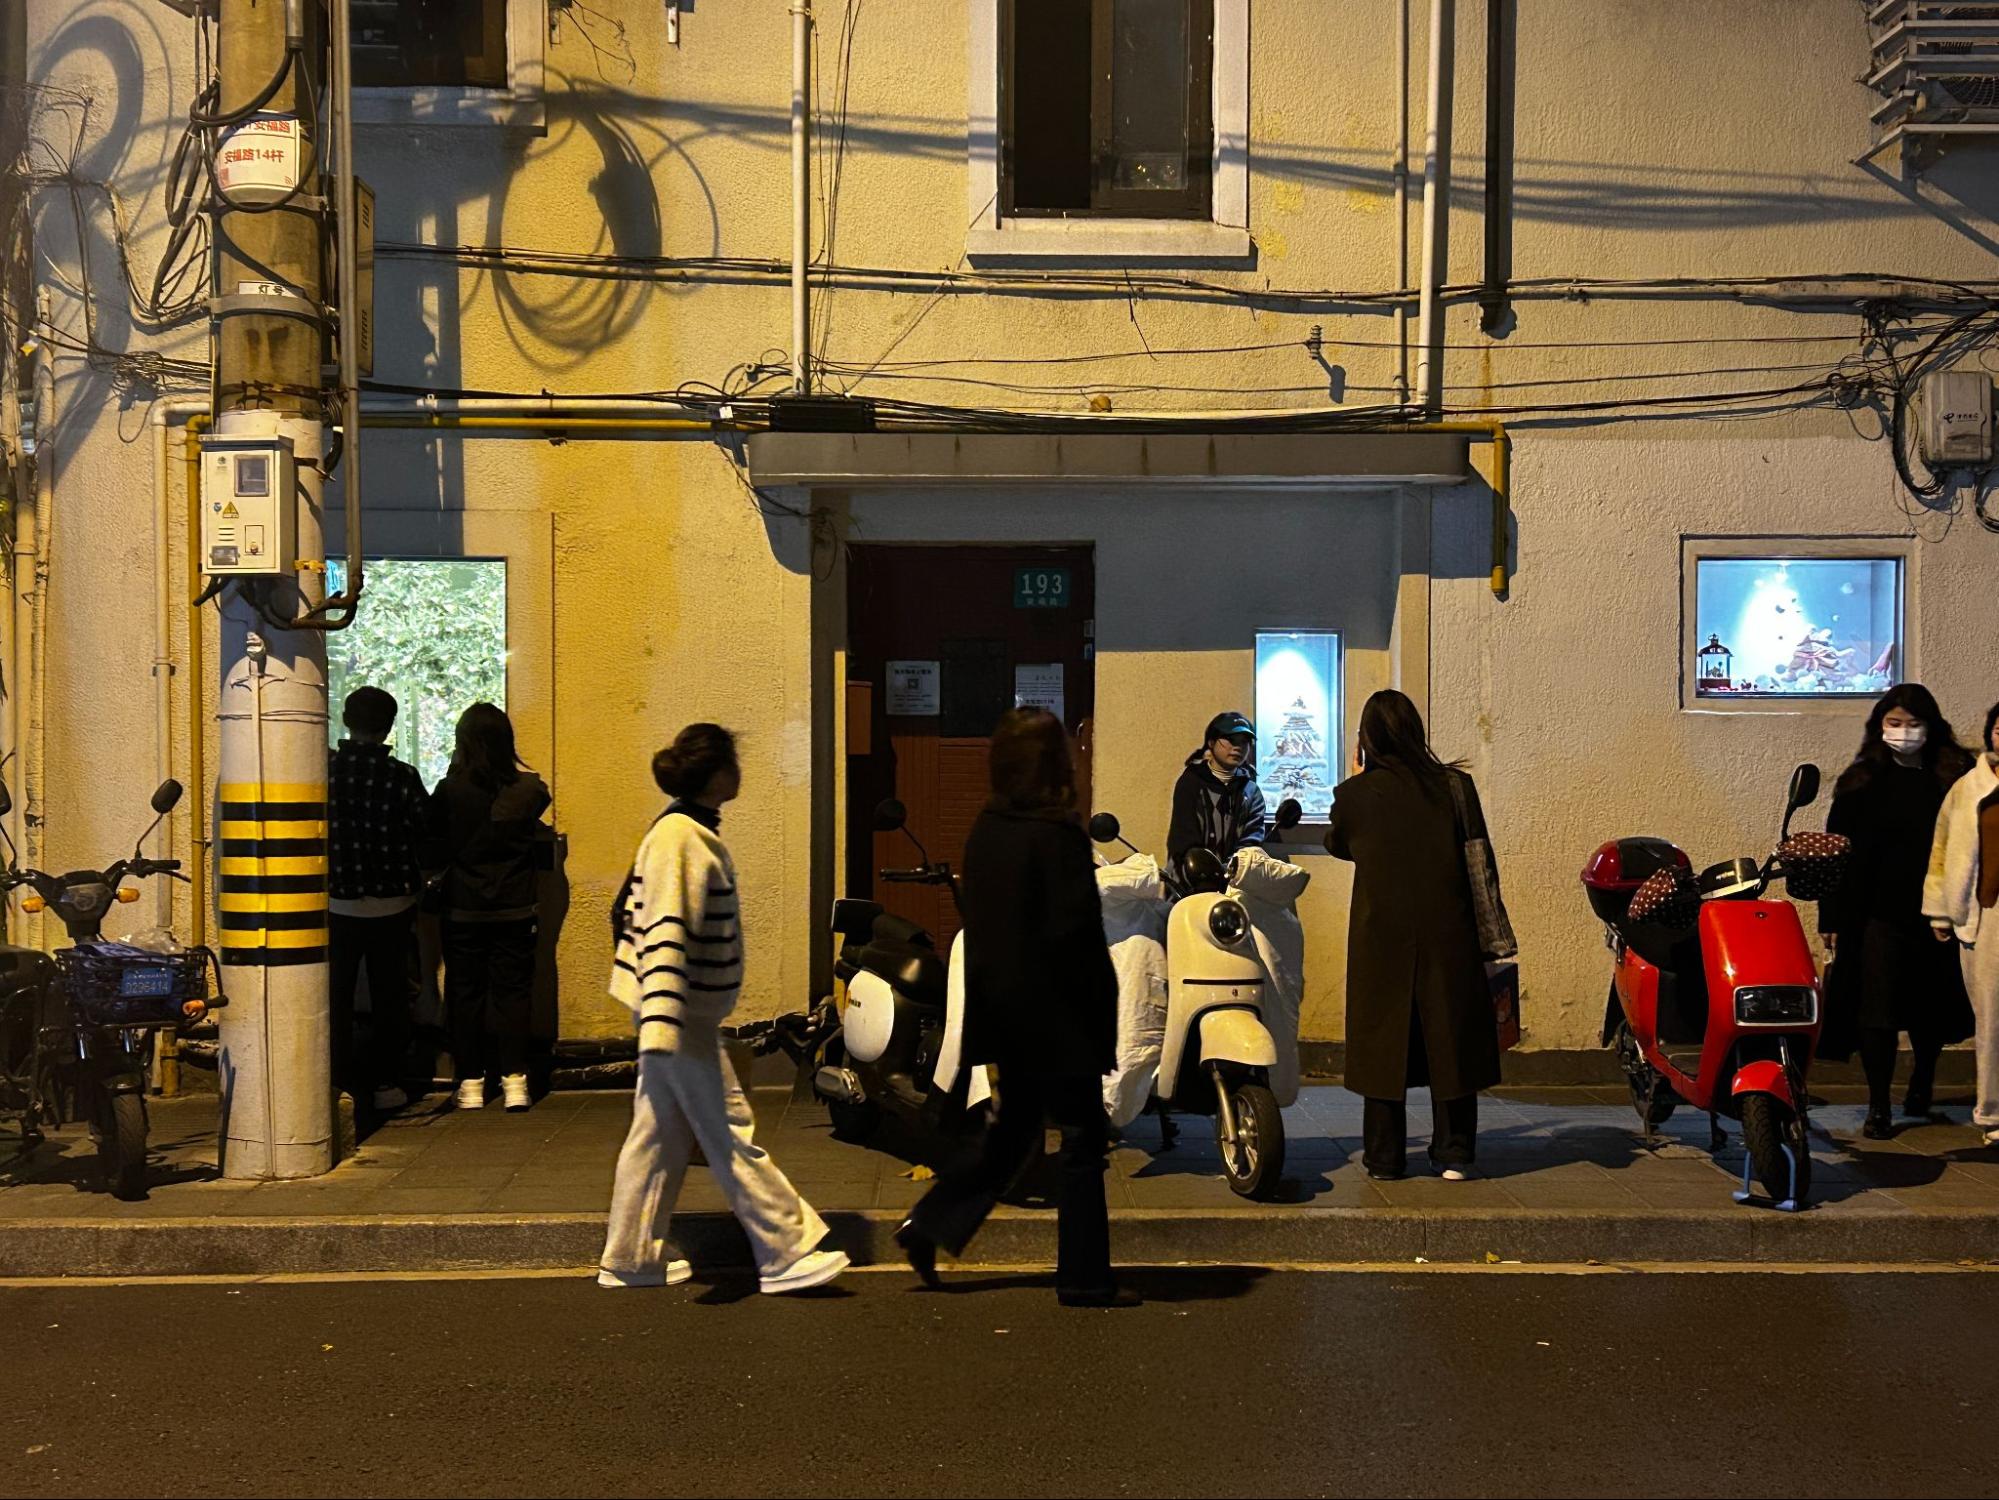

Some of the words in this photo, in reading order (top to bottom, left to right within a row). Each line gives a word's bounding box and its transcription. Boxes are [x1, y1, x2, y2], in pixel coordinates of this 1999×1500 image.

[224, 148, 285, 164] 安福路14杆
[1021, 573, 1063, 595] 193
